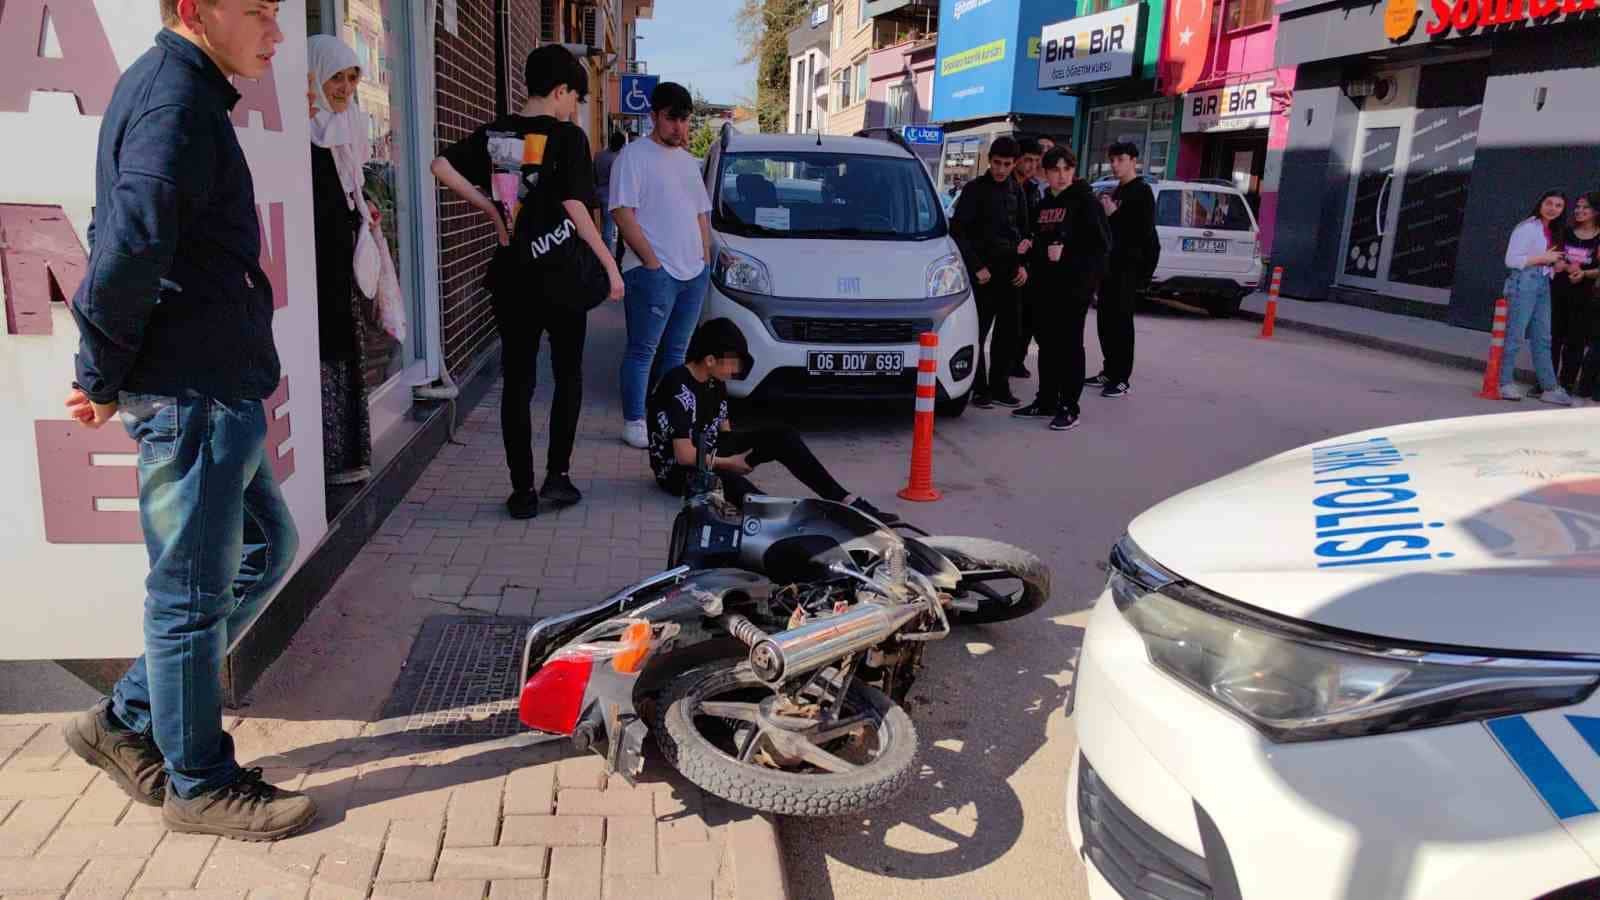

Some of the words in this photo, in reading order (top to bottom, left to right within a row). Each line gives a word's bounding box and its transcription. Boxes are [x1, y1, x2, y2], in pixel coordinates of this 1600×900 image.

[530, 218, 577, 259] NASA
[837, 276, 862, 295] FIAT
[817, 354, 834, 370] 06
[876, 354, 901, 370] 693
[1311, 472, 1456, 568] POLİSİ
